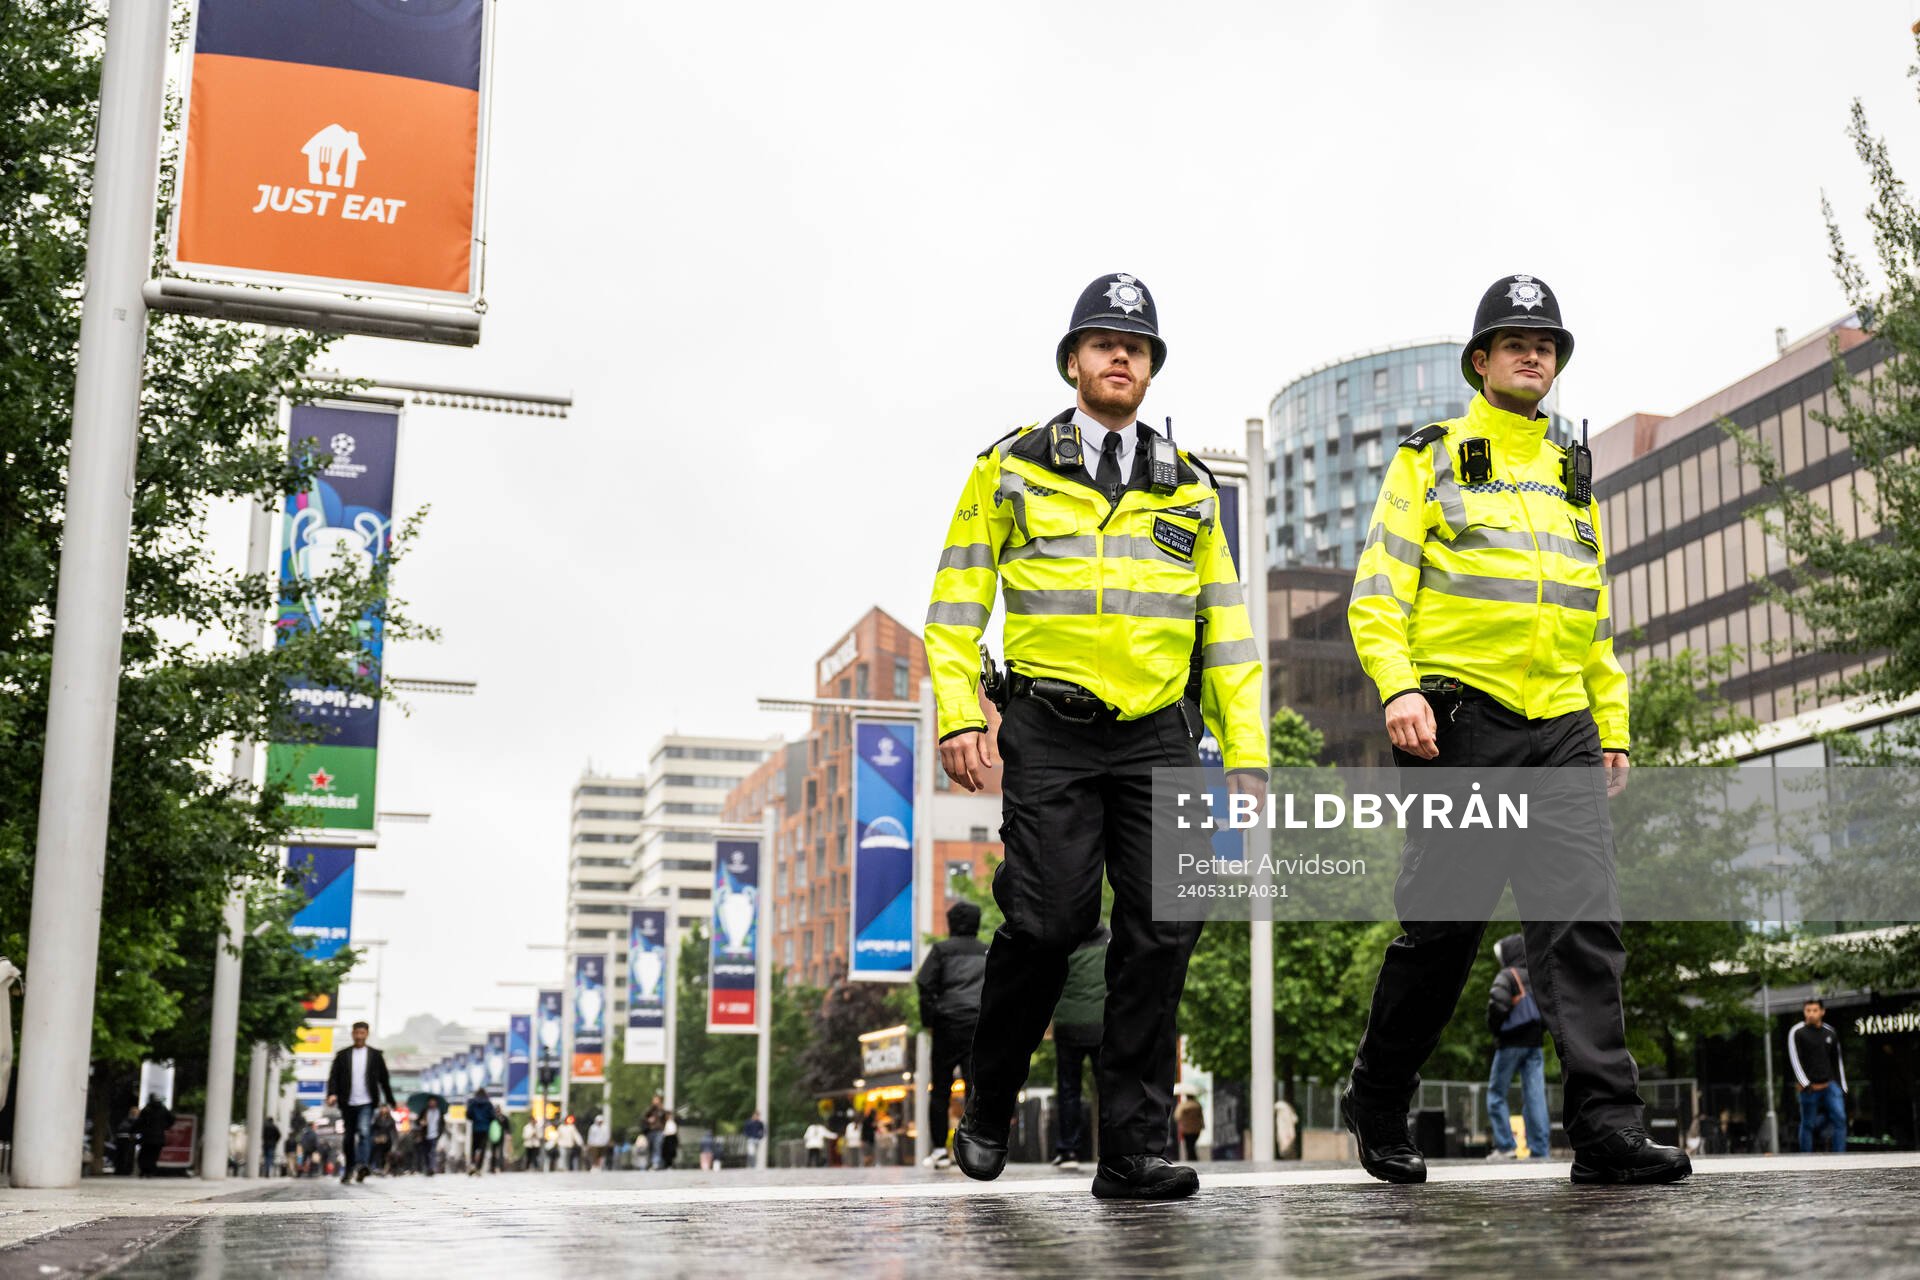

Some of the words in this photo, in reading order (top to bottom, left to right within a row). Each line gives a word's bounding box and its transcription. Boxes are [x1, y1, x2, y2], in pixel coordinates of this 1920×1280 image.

[252, 184, 337, 216] JUST
[341, 194, 407, 224] EAT
[1155, 532, 1171, 545] POLICE
[1171, 541, 1191, 554] OFFICER
[1169, 532, 1188, 544] POLICE
